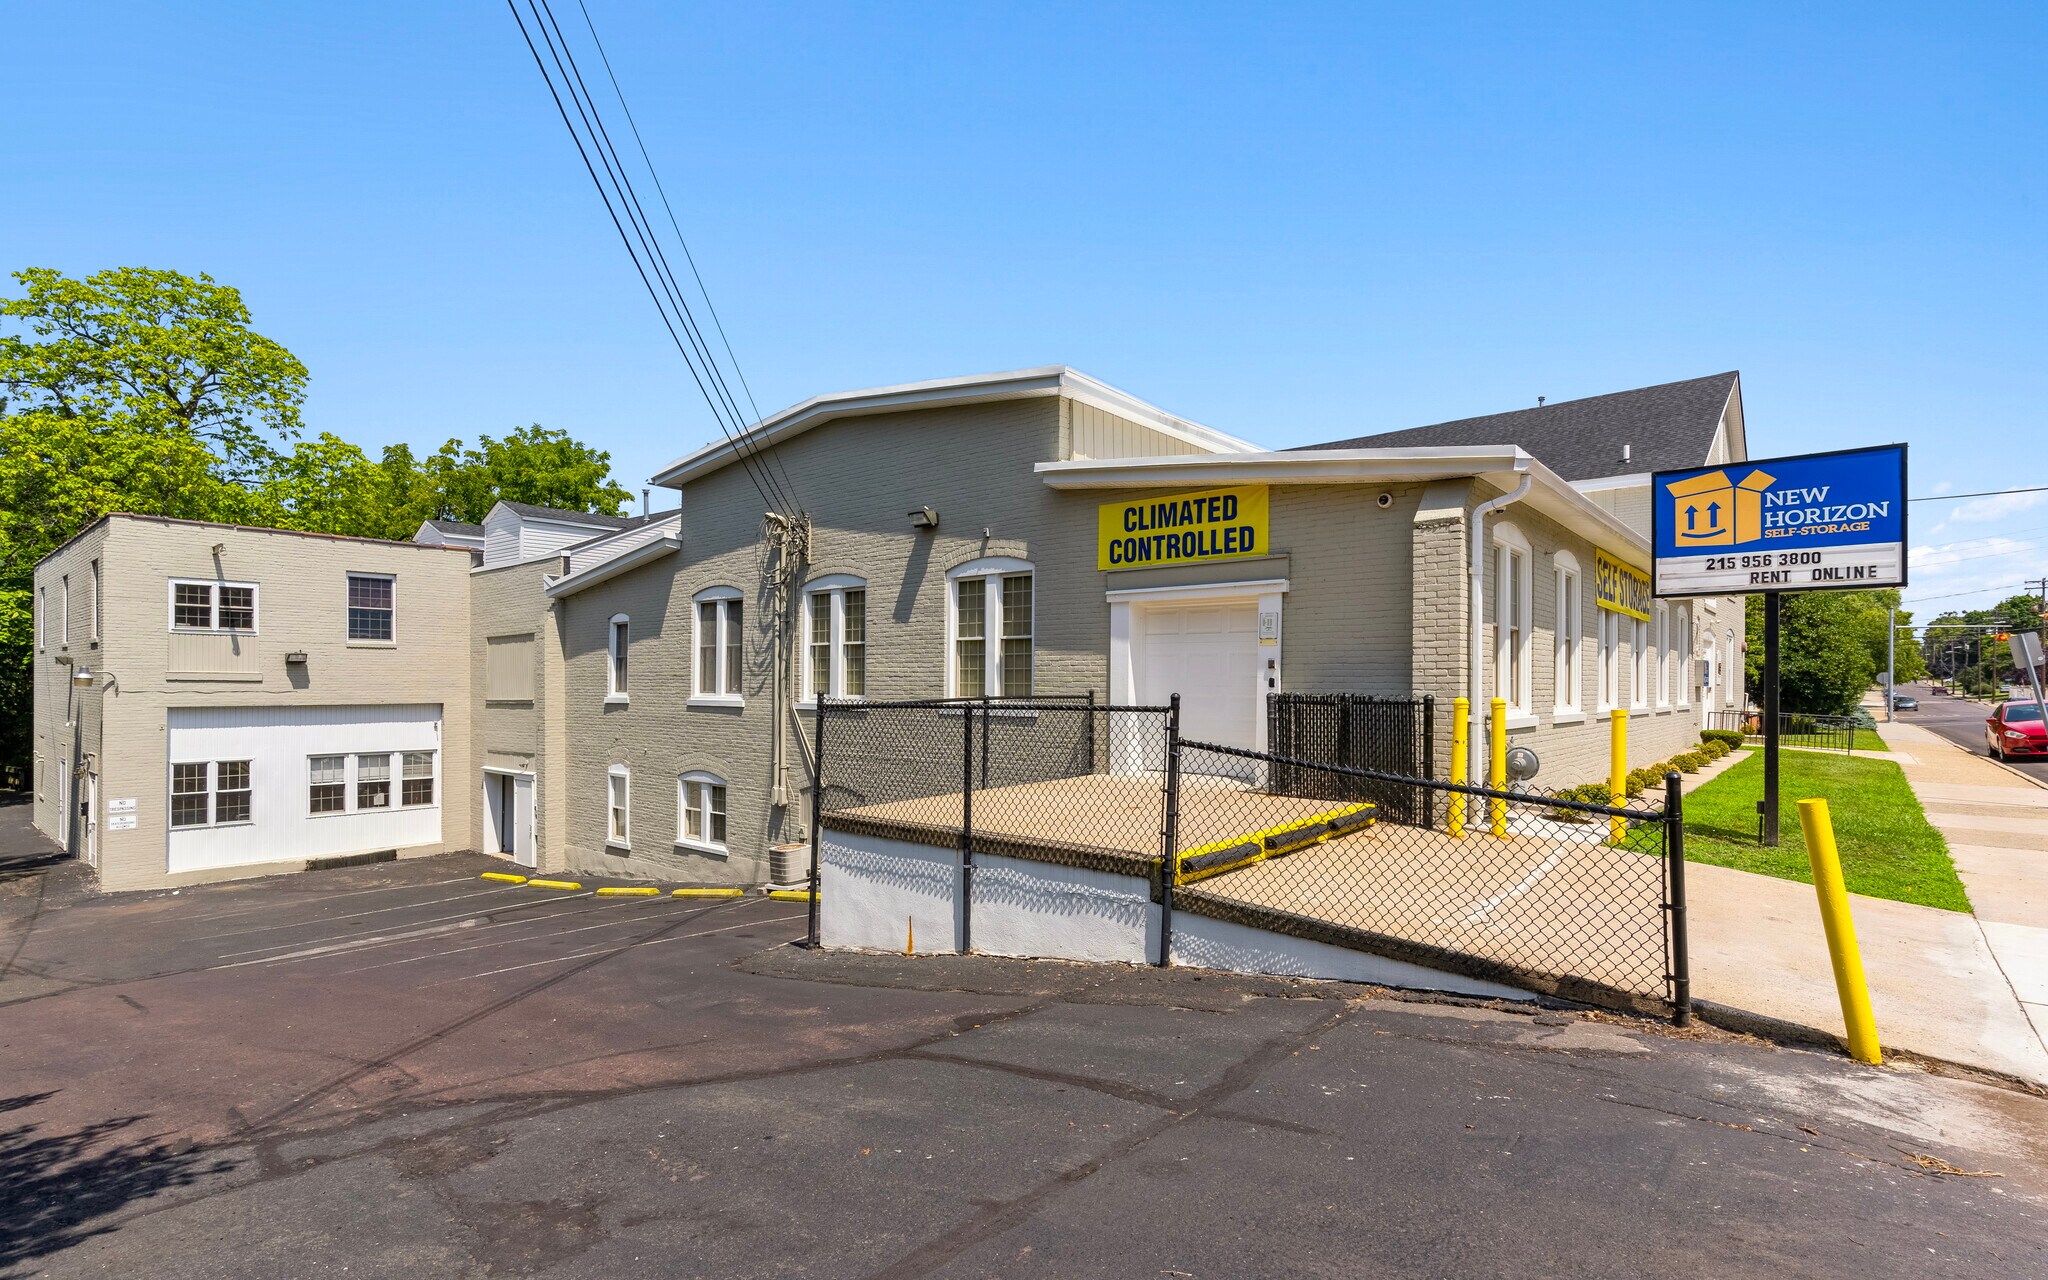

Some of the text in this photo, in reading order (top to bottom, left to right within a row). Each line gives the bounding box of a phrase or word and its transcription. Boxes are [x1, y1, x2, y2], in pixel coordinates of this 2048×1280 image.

[1764, 486, 1830, 508] NEW
[1124, 494, 1238, 532] CLIMATED
[1764, 501, 1890, 527] HORIZON
[1764, 521, 1870, 539] SELF-STORAGE
[1109, 526, 1255, 564] CONTROLLED
[1706, 551, 1822, 571] 215 956 3800
[1597, 557, 1617, 603] SELF
[1750, 565, 1877, 584] RENT ONLINE
